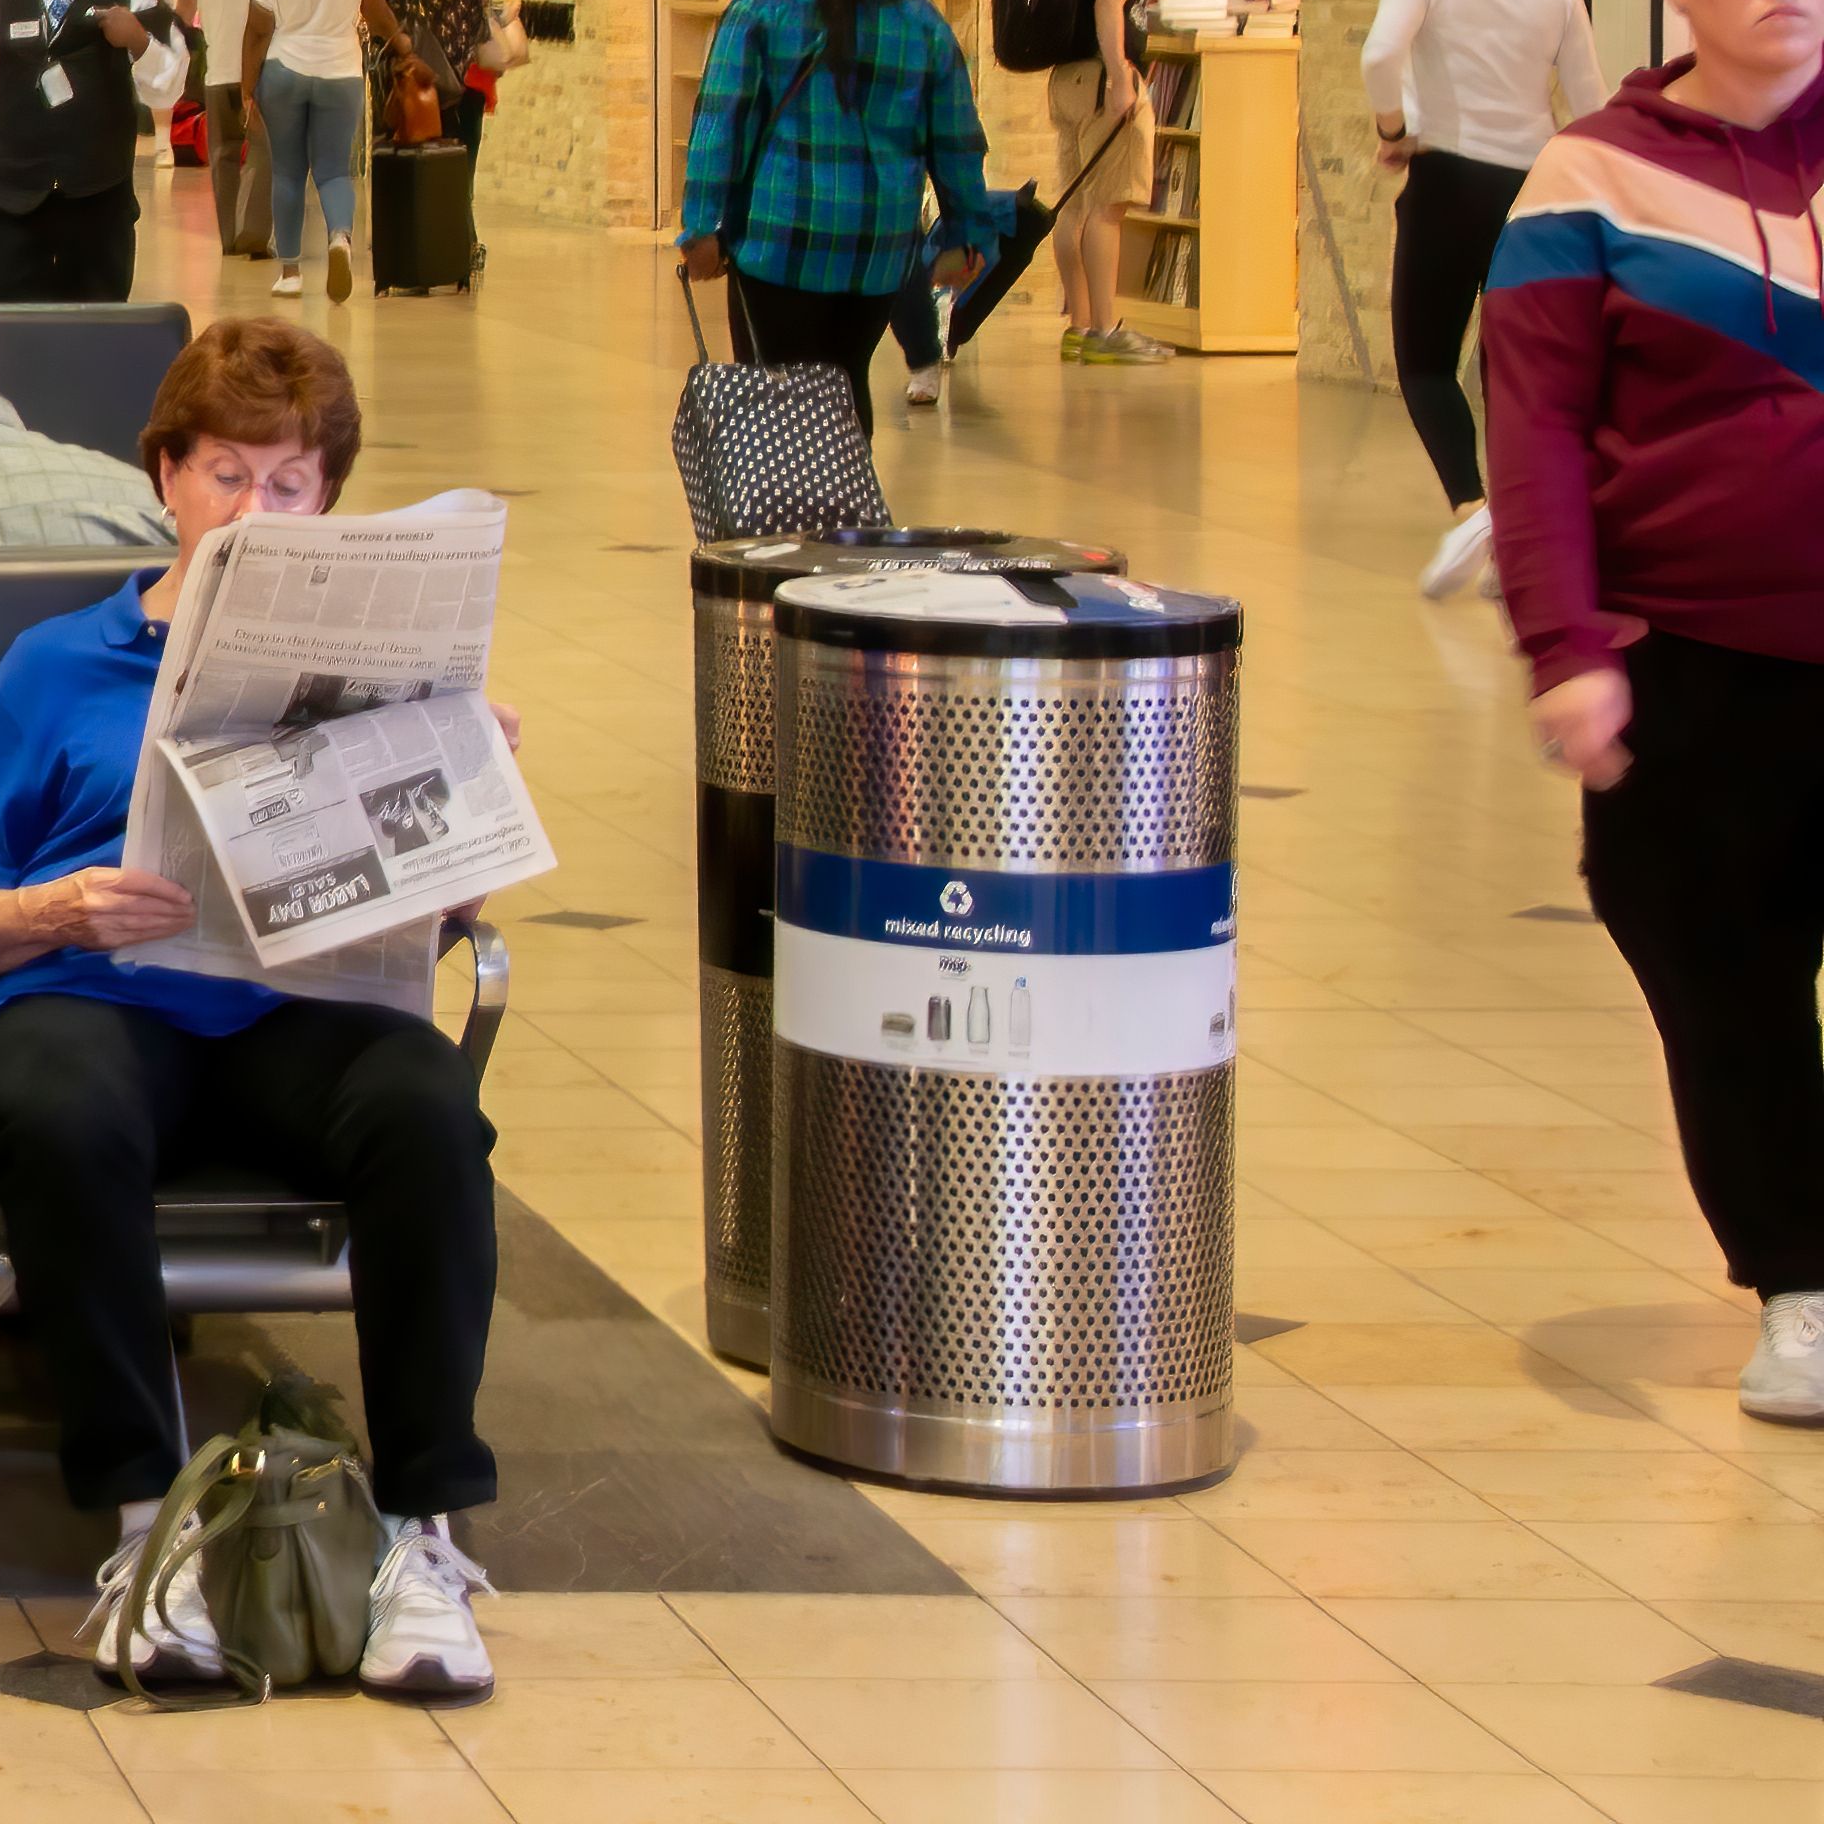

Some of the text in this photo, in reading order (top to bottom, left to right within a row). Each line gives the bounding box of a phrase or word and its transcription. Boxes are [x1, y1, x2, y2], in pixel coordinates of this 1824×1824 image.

[268, 872, 371, 924] LABOR DAY
[885, 917, 1033, 948] mixed recycling
